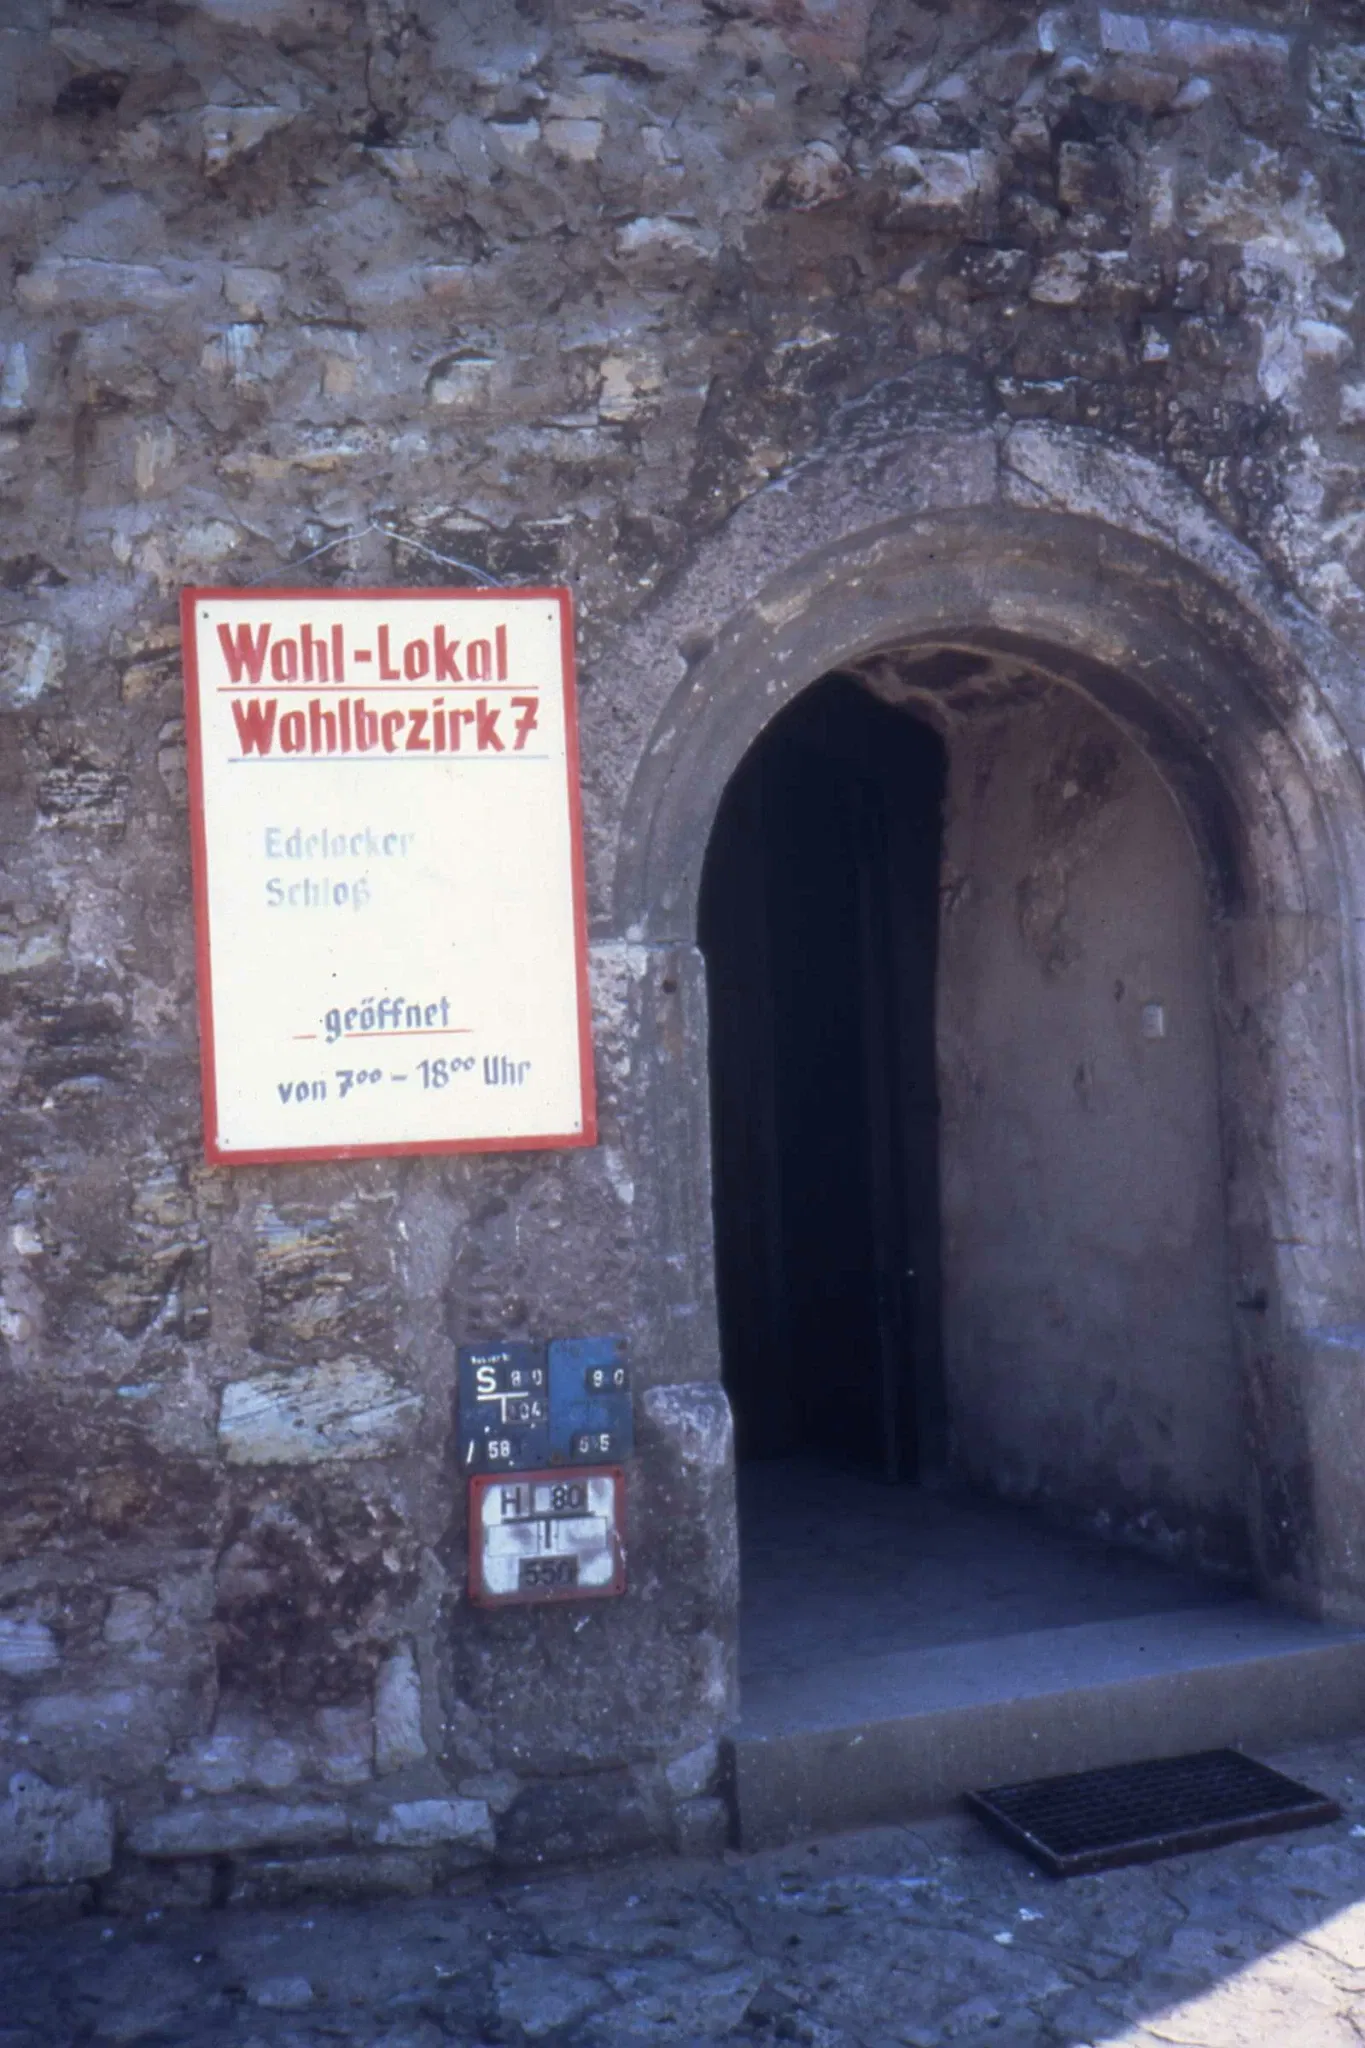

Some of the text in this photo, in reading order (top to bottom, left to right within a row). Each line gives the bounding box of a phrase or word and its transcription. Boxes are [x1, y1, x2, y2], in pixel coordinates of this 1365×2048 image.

[217, 622, 508, 684] Wahl-Lokal
[231, 697, 539, 756] Wahlbezirk 7
[264, 876, 372, 912] Schloß
[324, 996, 451, 1043] geöffnet
[277, 1081, 327, 1104] von
[483, 1054, 531, 1086] Uhr
[476, 1366, 497, 1393] S
[487, 1440, 511, 1459] 58
[501, 1485, 582, 1515] H 80
